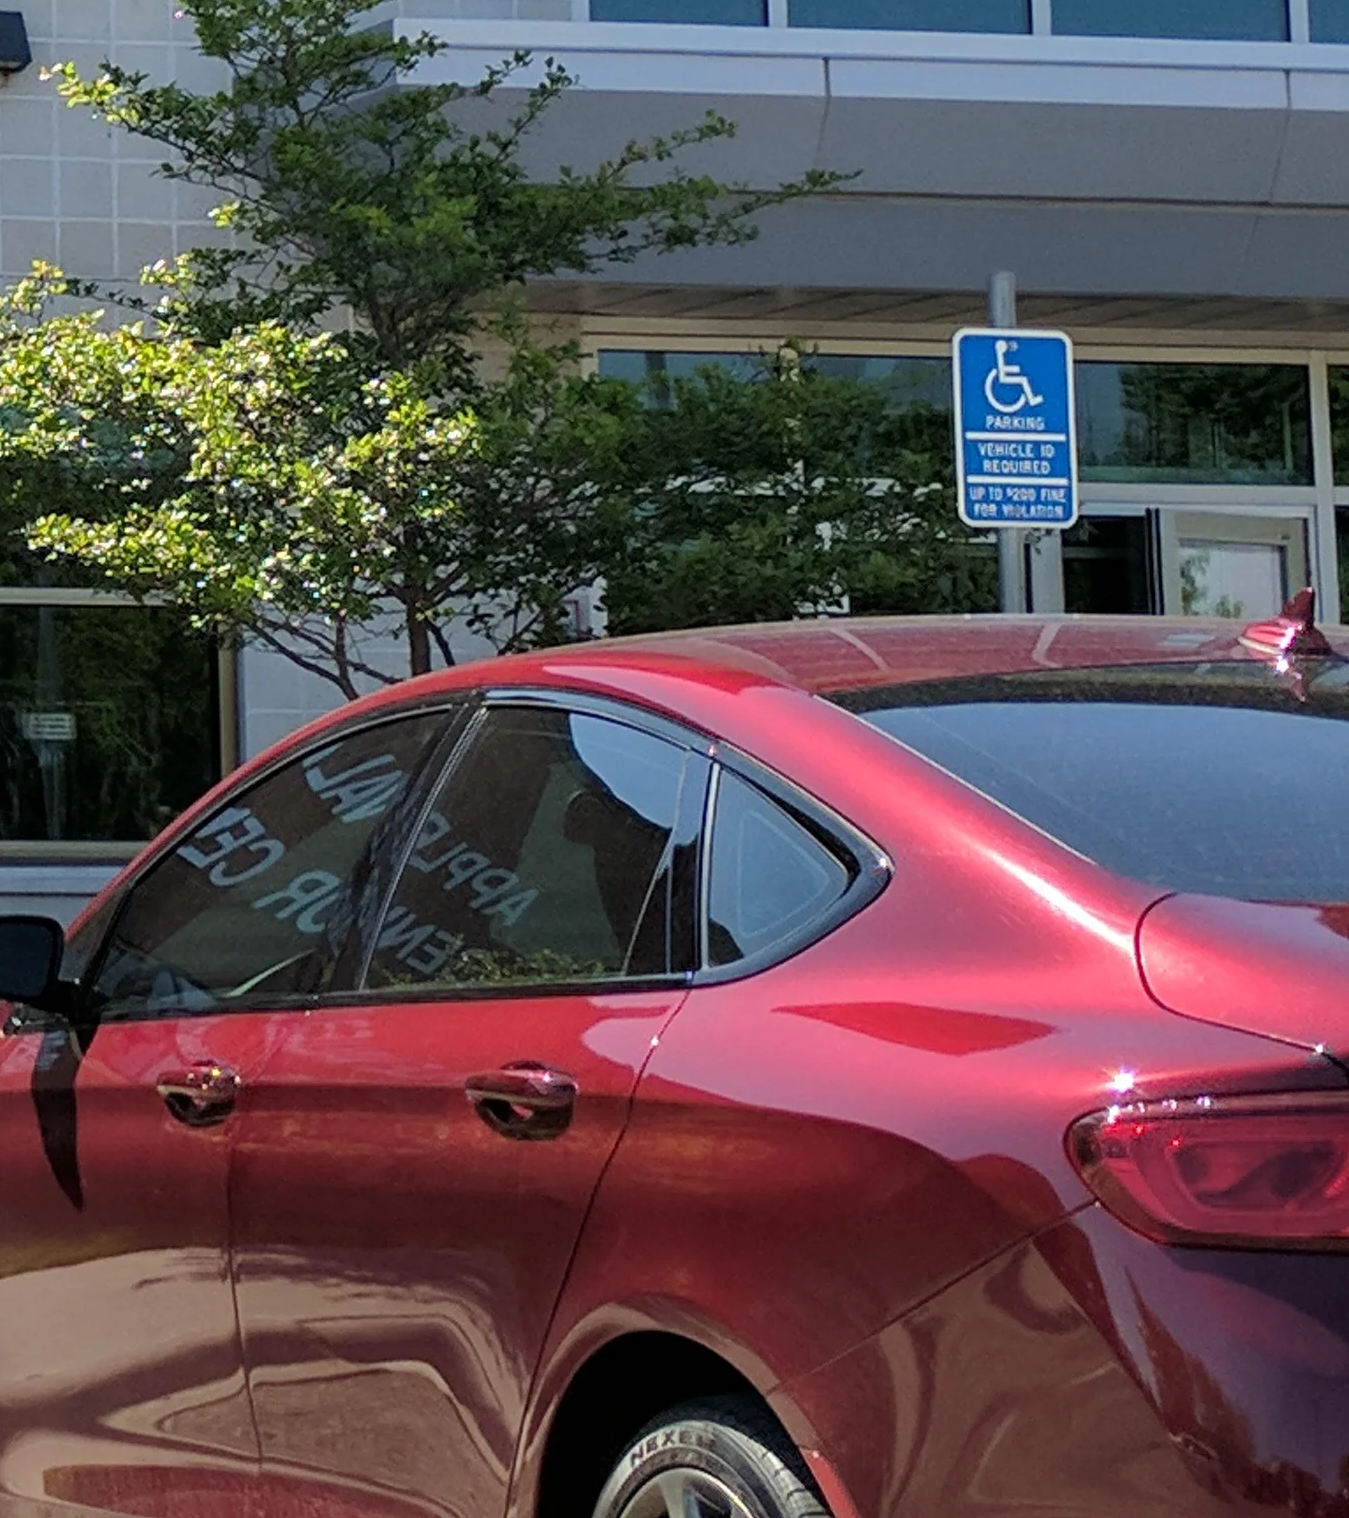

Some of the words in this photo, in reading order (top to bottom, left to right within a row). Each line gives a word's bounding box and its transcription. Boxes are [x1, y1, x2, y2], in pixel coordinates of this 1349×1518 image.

[985, 414, 1045, 431] PARKING
[978, 442, 1034, 458] VEHICLE
[1041, 444, 1055, 459] ID
[983, 459, 1051, 475] REQUIRED
[969, 486, 985, 500] UP
[988, 486, 1003, 501] TO
[1006, 487, 1036, 502] $200
[1041, 488, 1066, 503] FINE
[973, 503, 997, 518] FOR
[1002, 504, 1064, 520] VIOLATION
